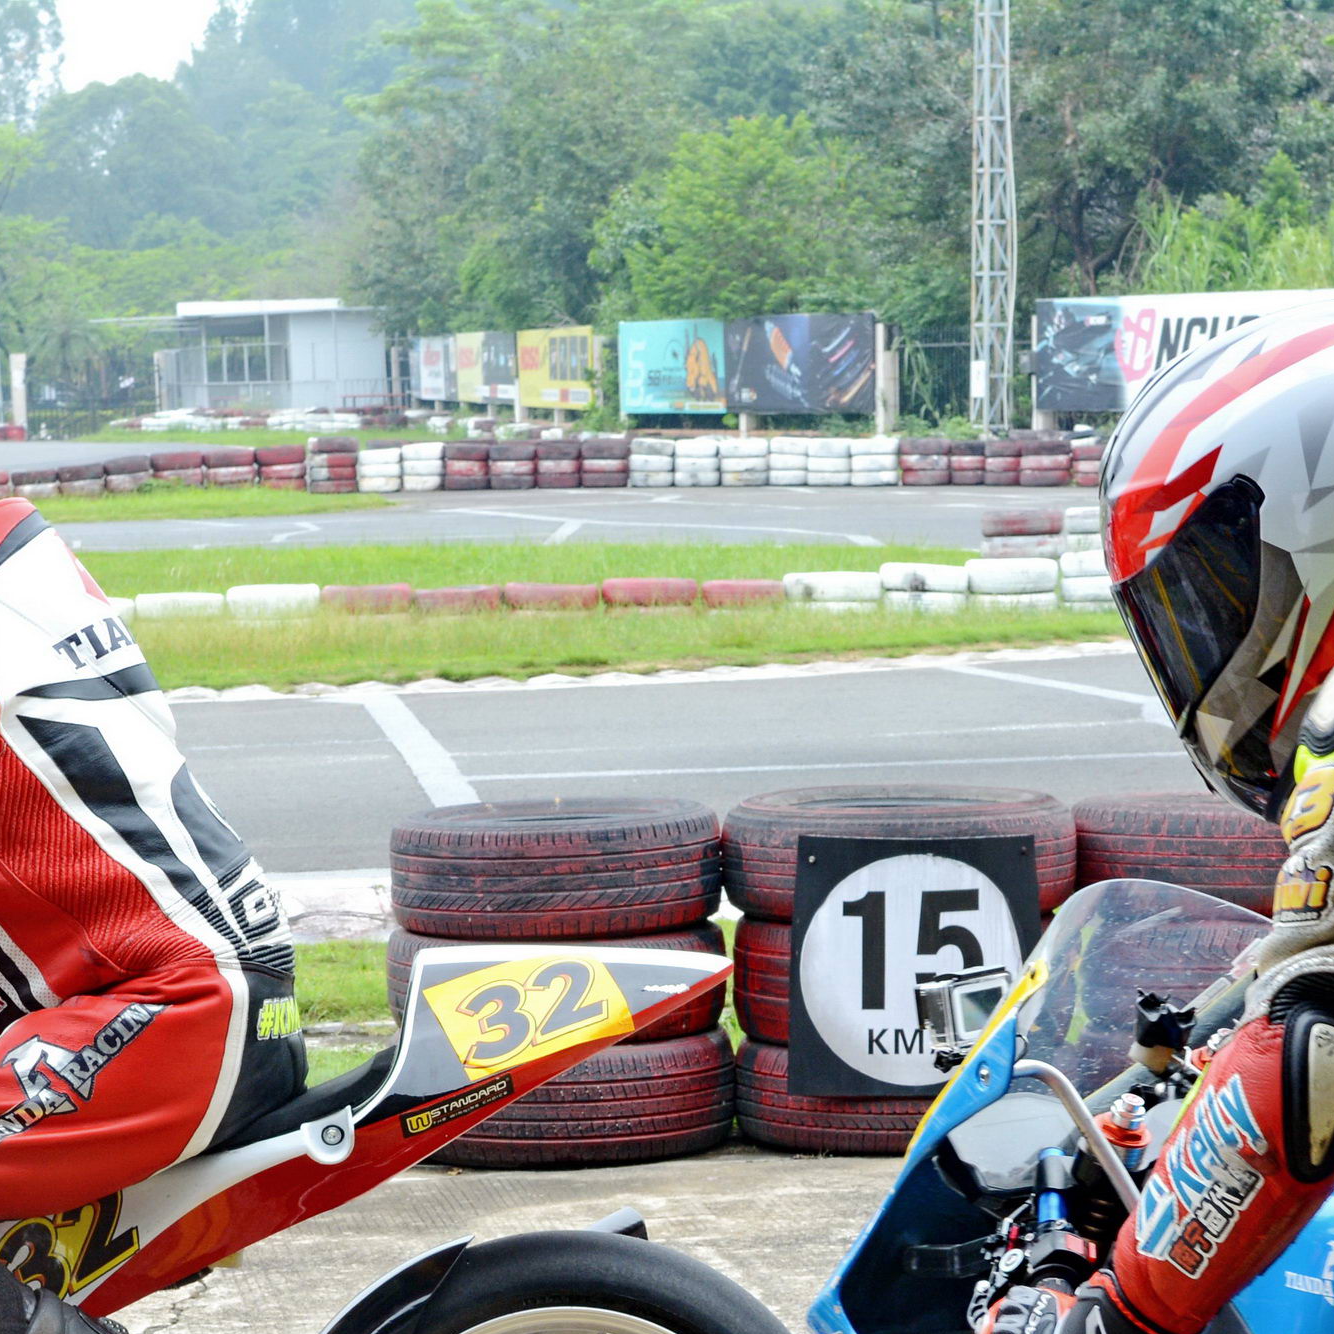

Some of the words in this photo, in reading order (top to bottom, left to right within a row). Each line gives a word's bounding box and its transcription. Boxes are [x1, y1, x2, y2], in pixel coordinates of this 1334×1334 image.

[52, 616, 137, 670] TIA
[844, 888, 990, 1011] 15
[462, 957, 609, 1067] 32
[868, 1028, 934, 1055] KM
[431, 1080, 507, 1118] STANDARD
[1284, 1270, 1334, 1298] TIANDA
